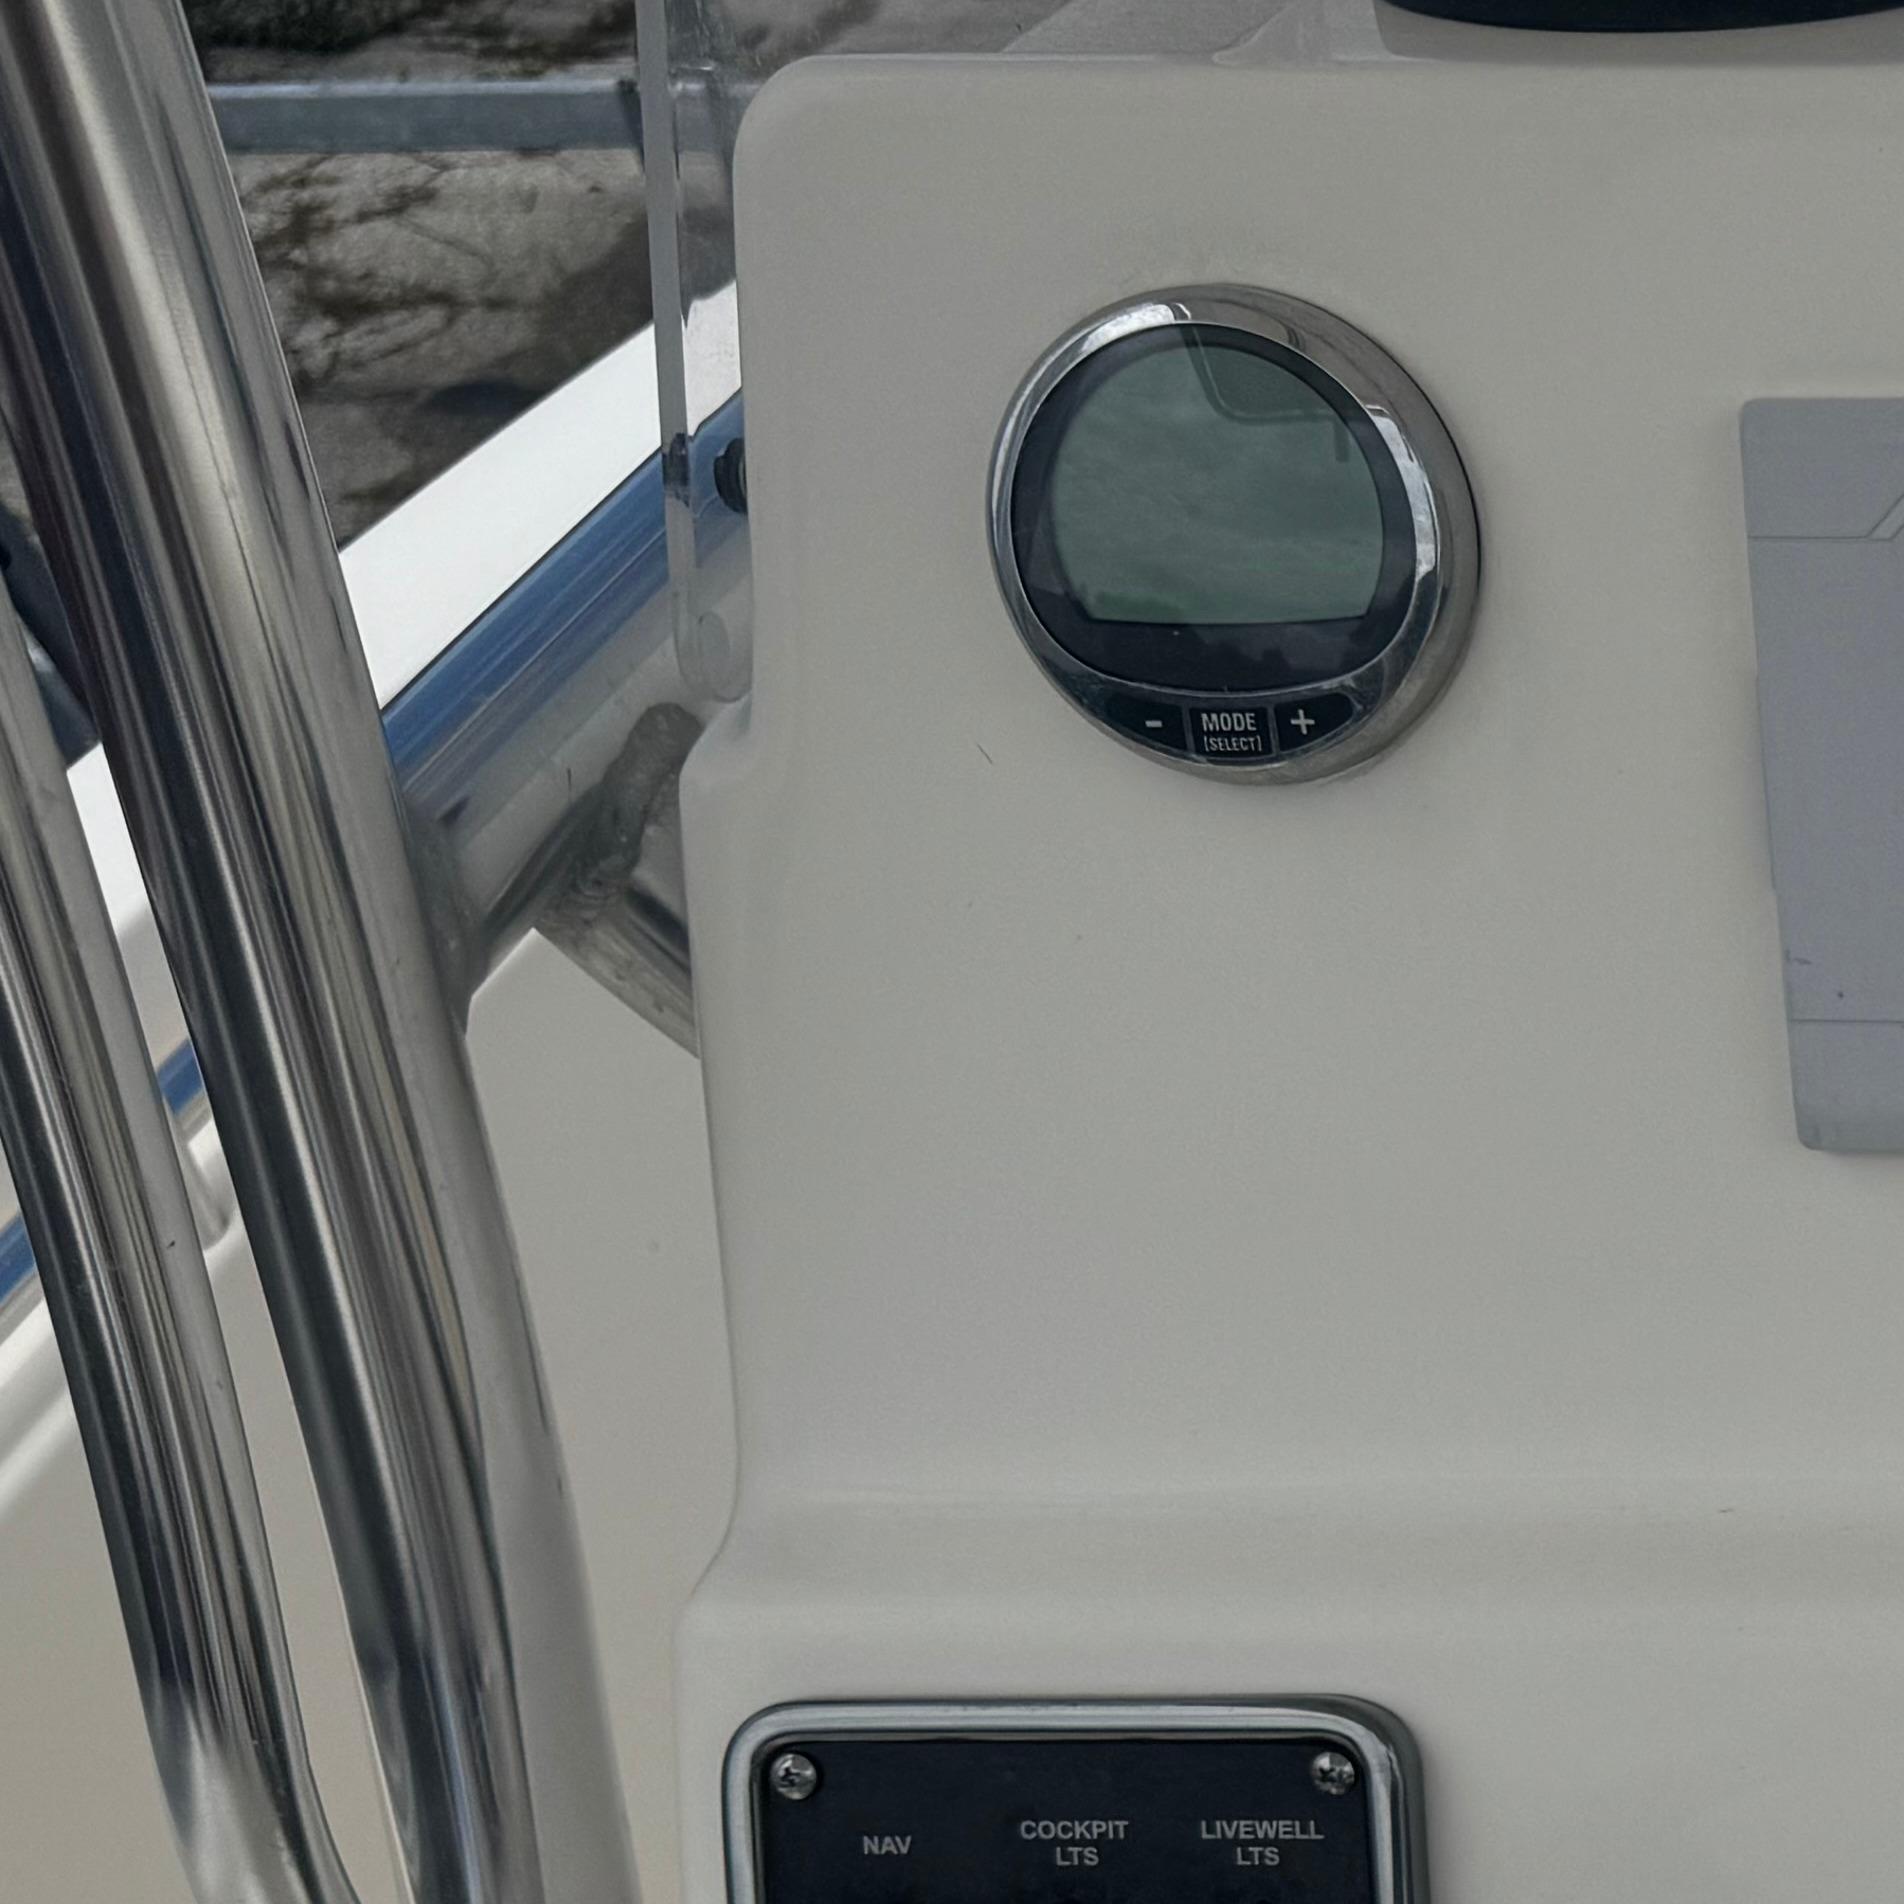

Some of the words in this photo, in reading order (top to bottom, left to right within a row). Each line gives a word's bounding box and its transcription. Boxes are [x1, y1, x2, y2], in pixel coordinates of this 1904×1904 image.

[1202, 713, 1257, 732] MODE
[1021, 1820, 1129, 1841] COCKPIT
[1202, 1820, 1325, 1841] LIVEWELL
[862, 1836, 912, 1856] NAV
[1056, 1847, 1099, 1867] LTS
[1237, 1847, 1280, 1867] LTS
